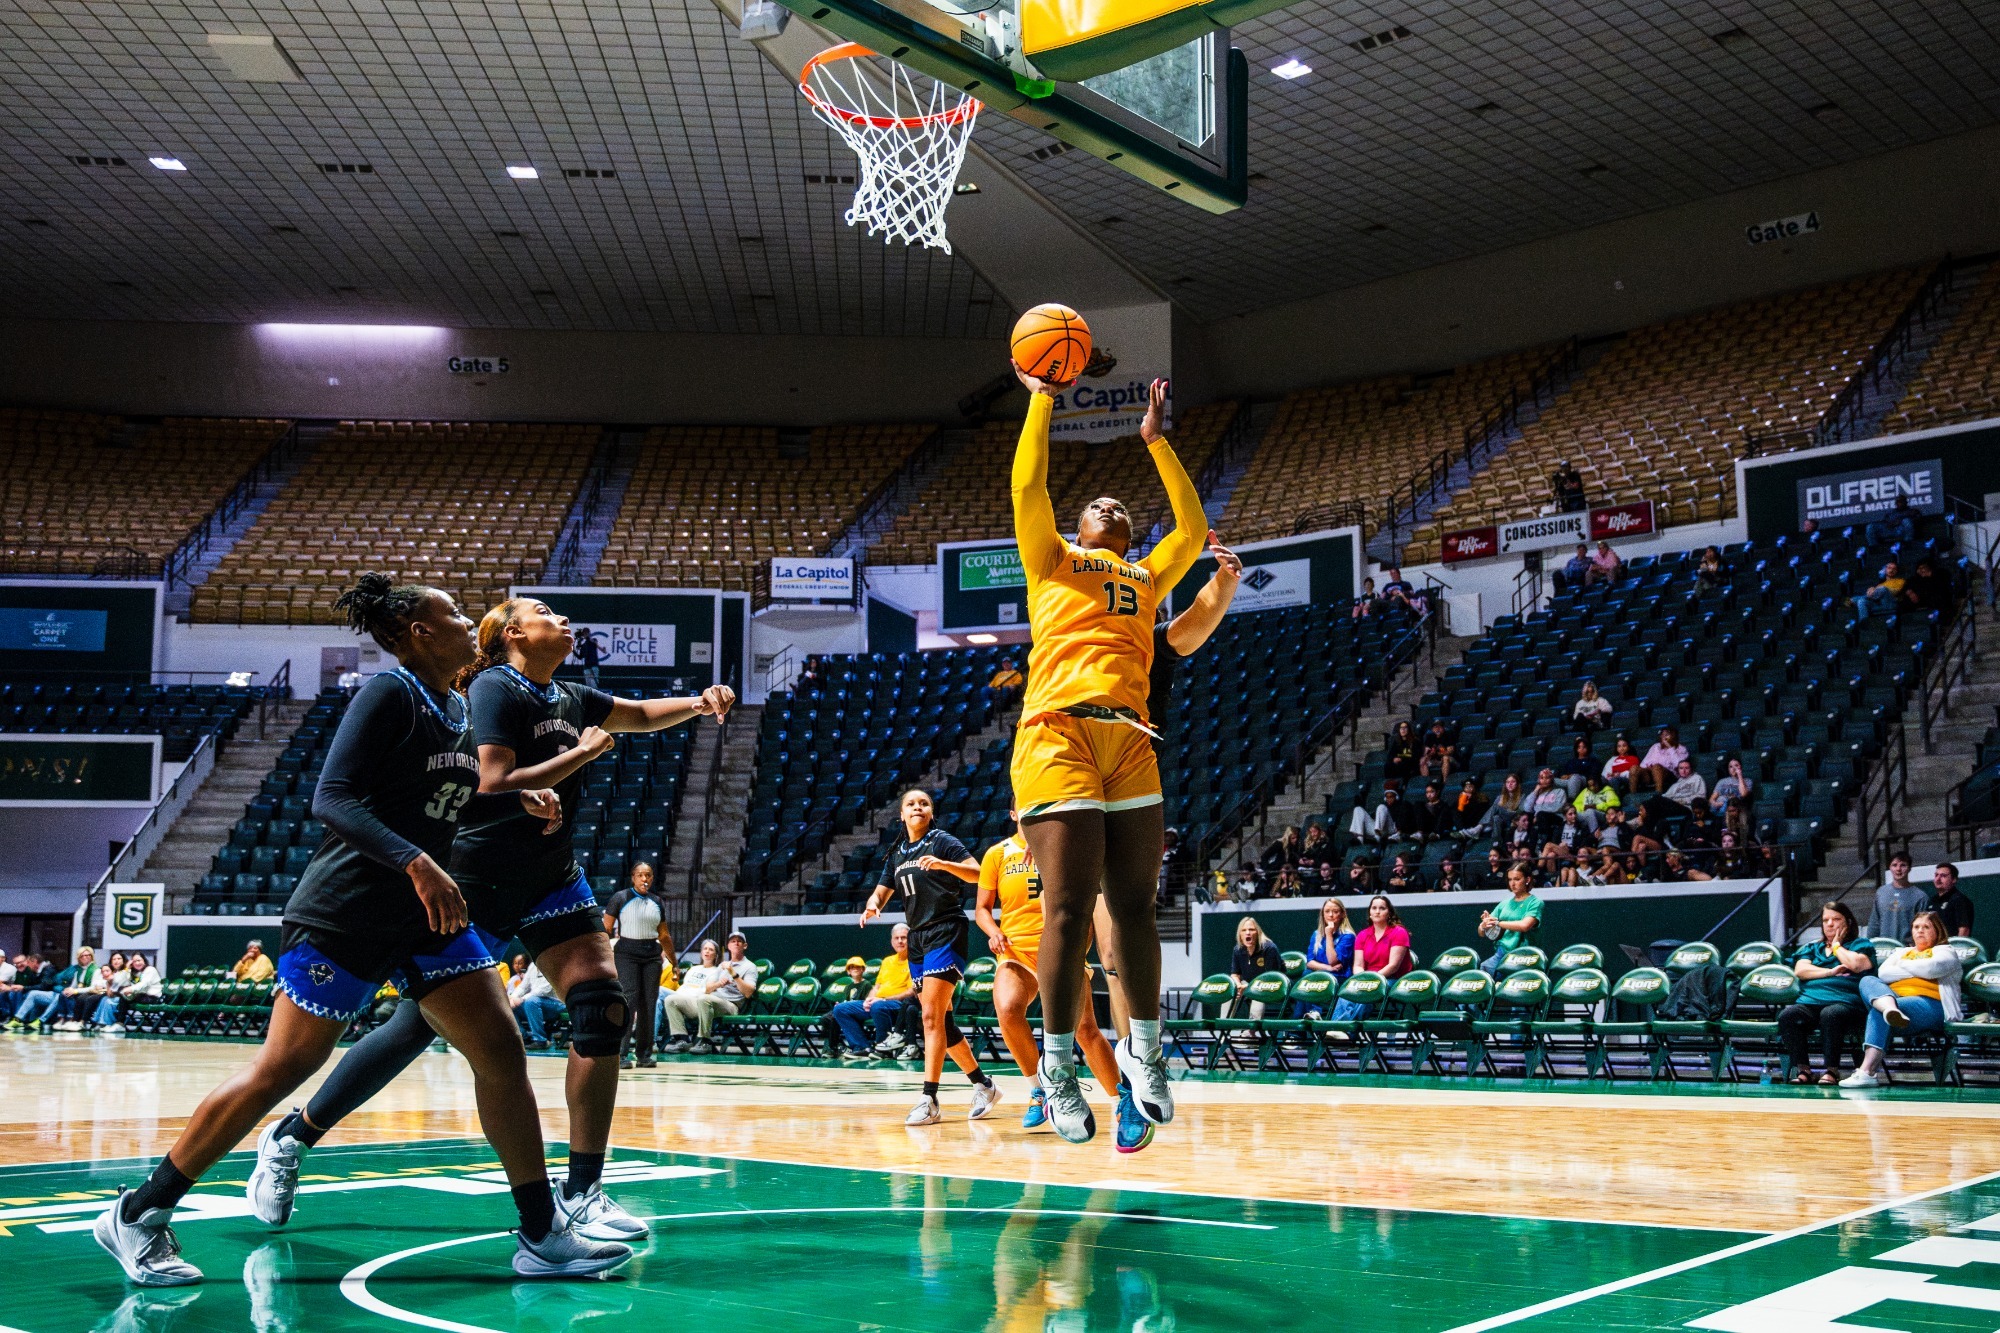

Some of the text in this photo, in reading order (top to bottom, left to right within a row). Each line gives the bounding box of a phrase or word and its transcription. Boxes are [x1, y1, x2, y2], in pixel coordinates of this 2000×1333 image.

[1747, 211, 1820, 243] Gate 4
[448, 357, 510, 373] Gate 5
[1053, 377, 1172, 412] a Capitl
[1049, 422, 1086, 433] DERAL
[1089, 419, 1132, 429] CREDIT
[1805, 470, 1932, 510] DUFRENE
[1806, 504, 1863, 520] BUILDING
[1504, 517, 1582, 542] CONCESSIONS
[965, 553, 1021, 568] COURTY
[1072, 558, 1114, 574] LADY
[775, 566, 849, 581] La Capitol
[1101, 580, 1139, 617] 13
[612, 627, 658, 640] FULL
[626, 654, 658, 663] TITLE
[533, 718, 581, 741] NEW ORLEAN
[426, 752, 456, 772] NEW
[1005, 863, 1030, 875] LADY
[900, 873, 916, 897] 11
[122, 902, 144, 925] S
[1440, 954, 1472, 966] Lions
[1507, 953, 1540, 965] Lions
[1559, 953, 1594, 965] Lions
[1675, 950, 1712, 963] Lions
[1736, 951, 1773, 963] Lions
[968, 963, 993, 973] Lions
[1450, 979, 1486, 991] Lions
[1505, 979, 1541, 991] Lions
[1563, 979, 1600, 991] Lions
[1622, 978, 1662, 991] Lions
[1750, 974, 1793, 988] Lions
[1972, 972, 2000, 985] Lio
[1200, 982, 1228, 993] Lions
[1251, 979, 1281, 992] Lions
[1300, 979, 1329, 992] Lions
[1347, 979, 1380, 992] Lions
[1398, 979, 1431, 992] Lions
